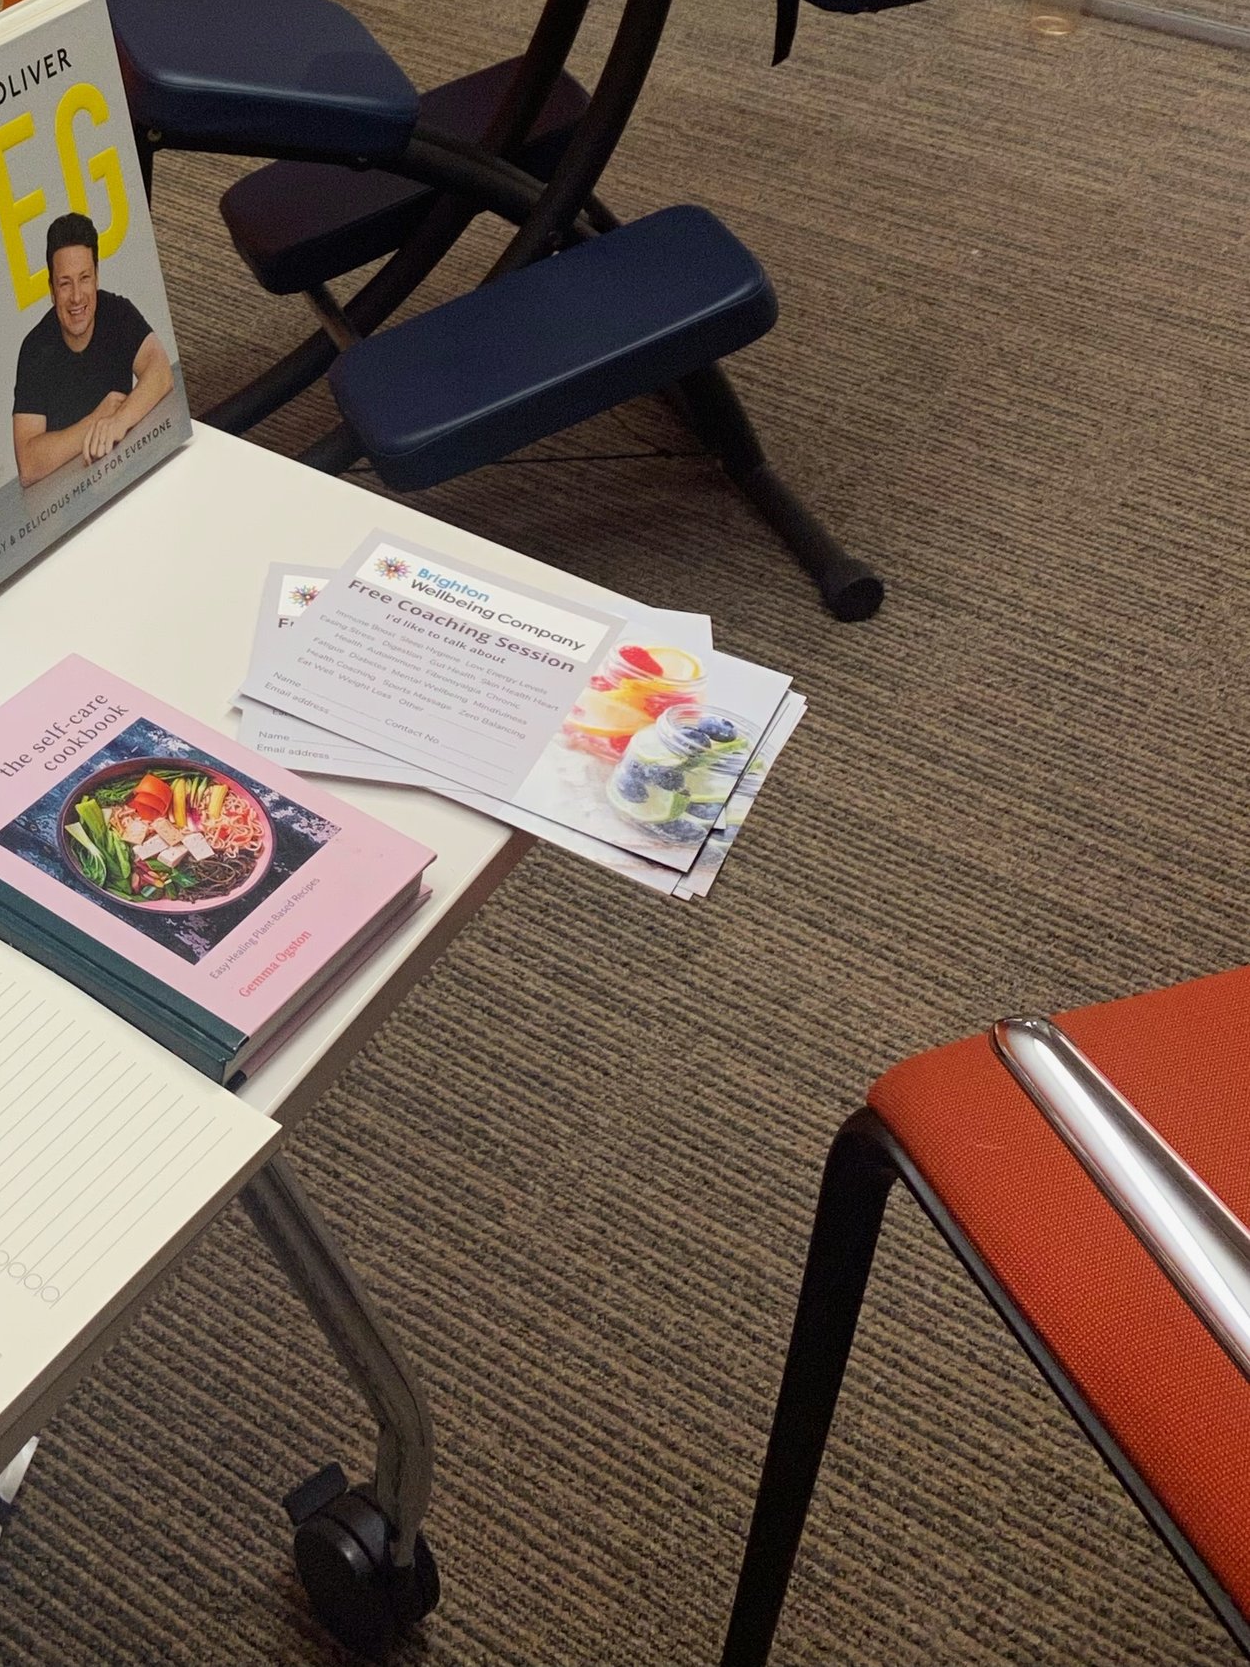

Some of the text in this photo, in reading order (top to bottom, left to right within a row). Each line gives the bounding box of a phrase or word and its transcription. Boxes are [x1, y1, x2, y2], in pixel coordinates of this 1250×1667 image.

[9, 536, 17, 547] &
[18, 494, 72, 540] DELICIOUS
[71, 468, 104, 500] MEALS
[103, 455, 124, 475] FOR
[124, 417, 173, 460] EVERYONE
[410, 578, 587, 653] Wellbeing Company
[415, 567, 491, 603] Brighton
[347, 579, 577, 674] Free Coaching Session
[385, 613, 508, 666] I'd like to talk about
[0, 693, 109, 778] the self-care
[43, 704, 130, 772] cookbook
[256, 743, 331, 761] Email address
[258, 730, 291, 742] Name
[209, 877, 321, 981] Easy Healing Plant-Based Recipes
[238, 929, 312, 999] Gemma Ogston
